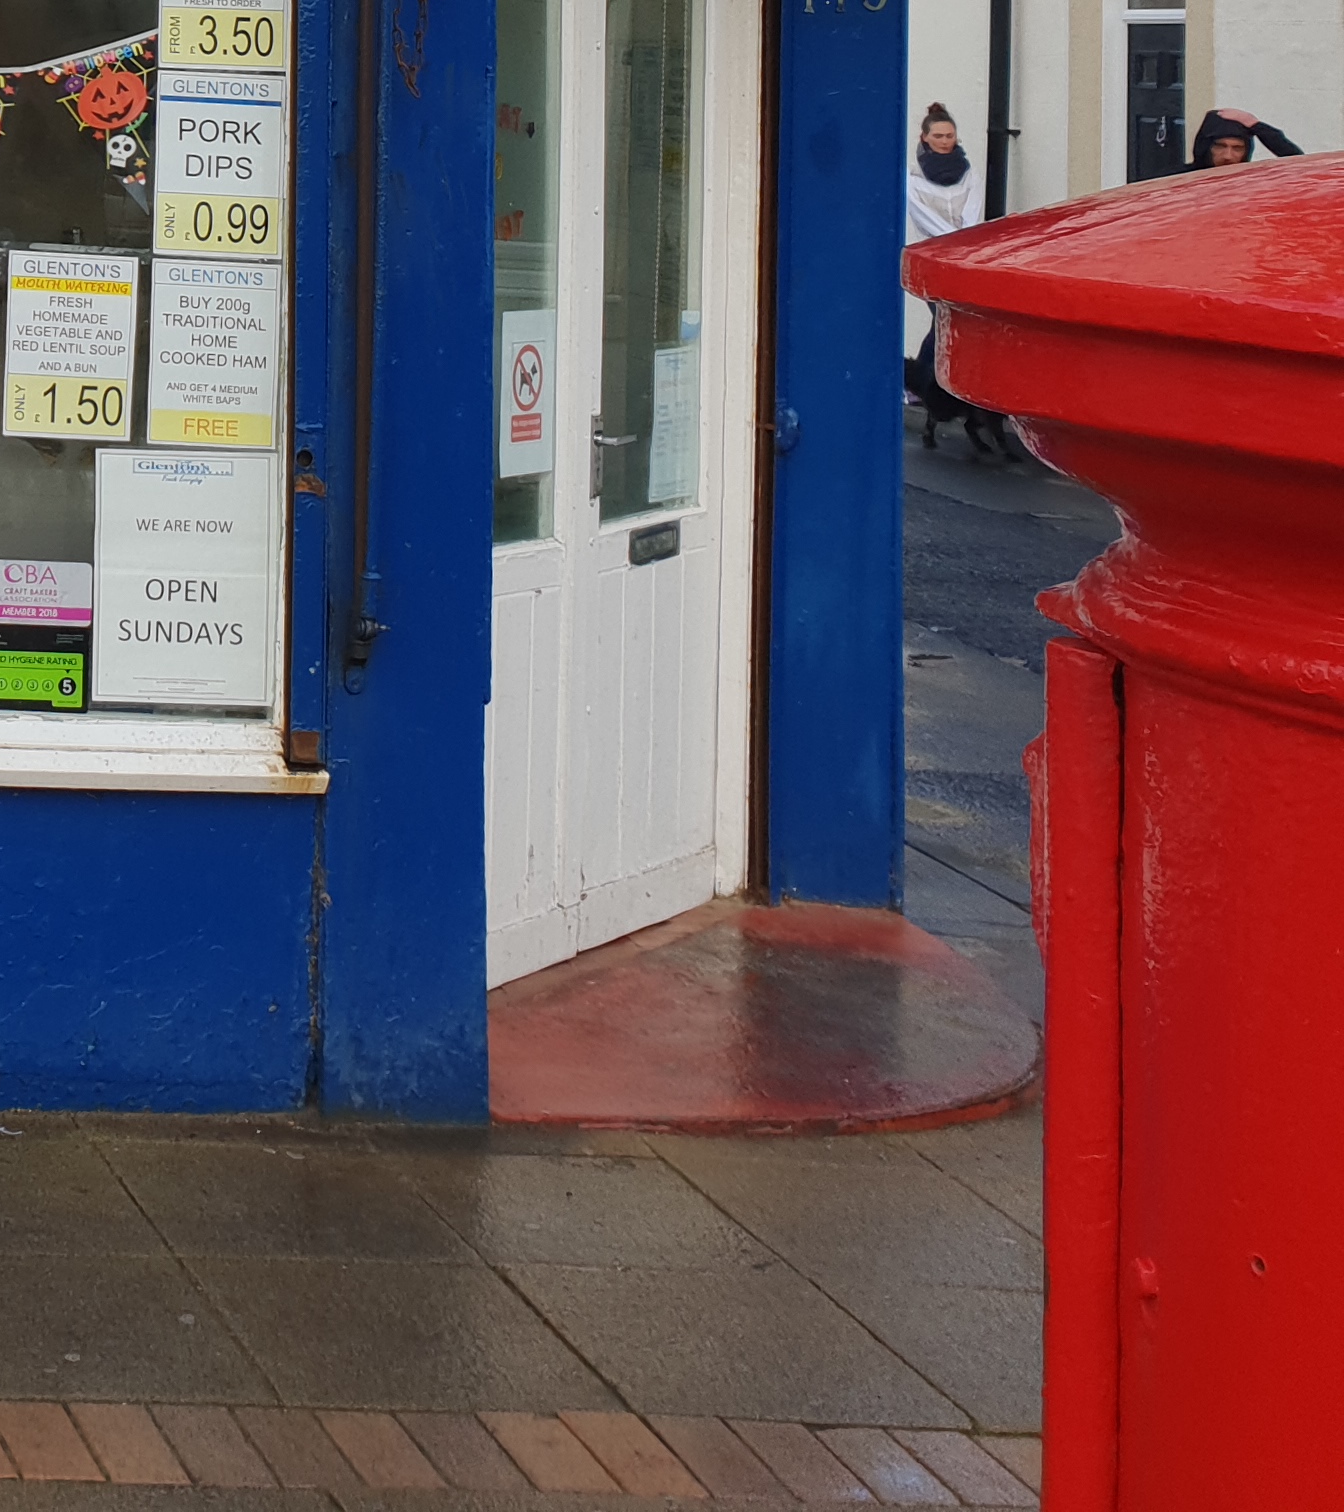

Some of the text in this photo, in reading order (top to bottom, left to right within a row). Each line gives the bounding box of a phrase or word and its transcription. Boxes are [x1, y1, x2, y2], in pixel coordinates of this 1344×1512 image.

[170, 16, 181, 54] FROM
[61, 42, 145, 74] Halloween
[173, 79, 269, 98] GLENTON'S
[178, 118, 262, 145] PORK
[185, 154, 253, 180] DIPS
[164, 202, 176, 238] ONLY
[24, 260, 121, 278] GLENTON'S
[169, 268, 263, 286] GLENTON'S
[16, 277, 129, 294] MOUTH WATERING
[49, 296, 93, 309] FRESH
[179, 296, 251, 315] BUY 200g
[33, 311, 108, 325] HOMEMADE
[162, 313, 267, 331] TRADITIONAL
[16, 325, 123, 341] VEGETABLE AND
[191, 333, 238, 349] HOME
[12, 340, 126, 356] RED LENTIL SOUP
[38, 361, 97, 373] AND A BUN
[160, 351, 267, 369] COOKED HAM
[166, 382, 187, 391] AND
[190, 384, 209, 392] GET
[219, 386, 258, 395] MEDIUM
[14, 384, 26, 421] ONLY
[182, 394, 241, 405] WHITE BAPS
[184, 418, 239, 437] FREE
[136, 519, 234, 534] WE ARE NOW
[4, 563, 57, 585] CBA
[145, 579, 217, 603] OPEN
[1, 607, 58, 617] MEMBER 2018
[118, 619, 243, 645] SUNDAYS
[9, 656, 45, 664] HYGIENE
[47, 657, 77, 665] RATING
[62, 679, 72, 694] 5
